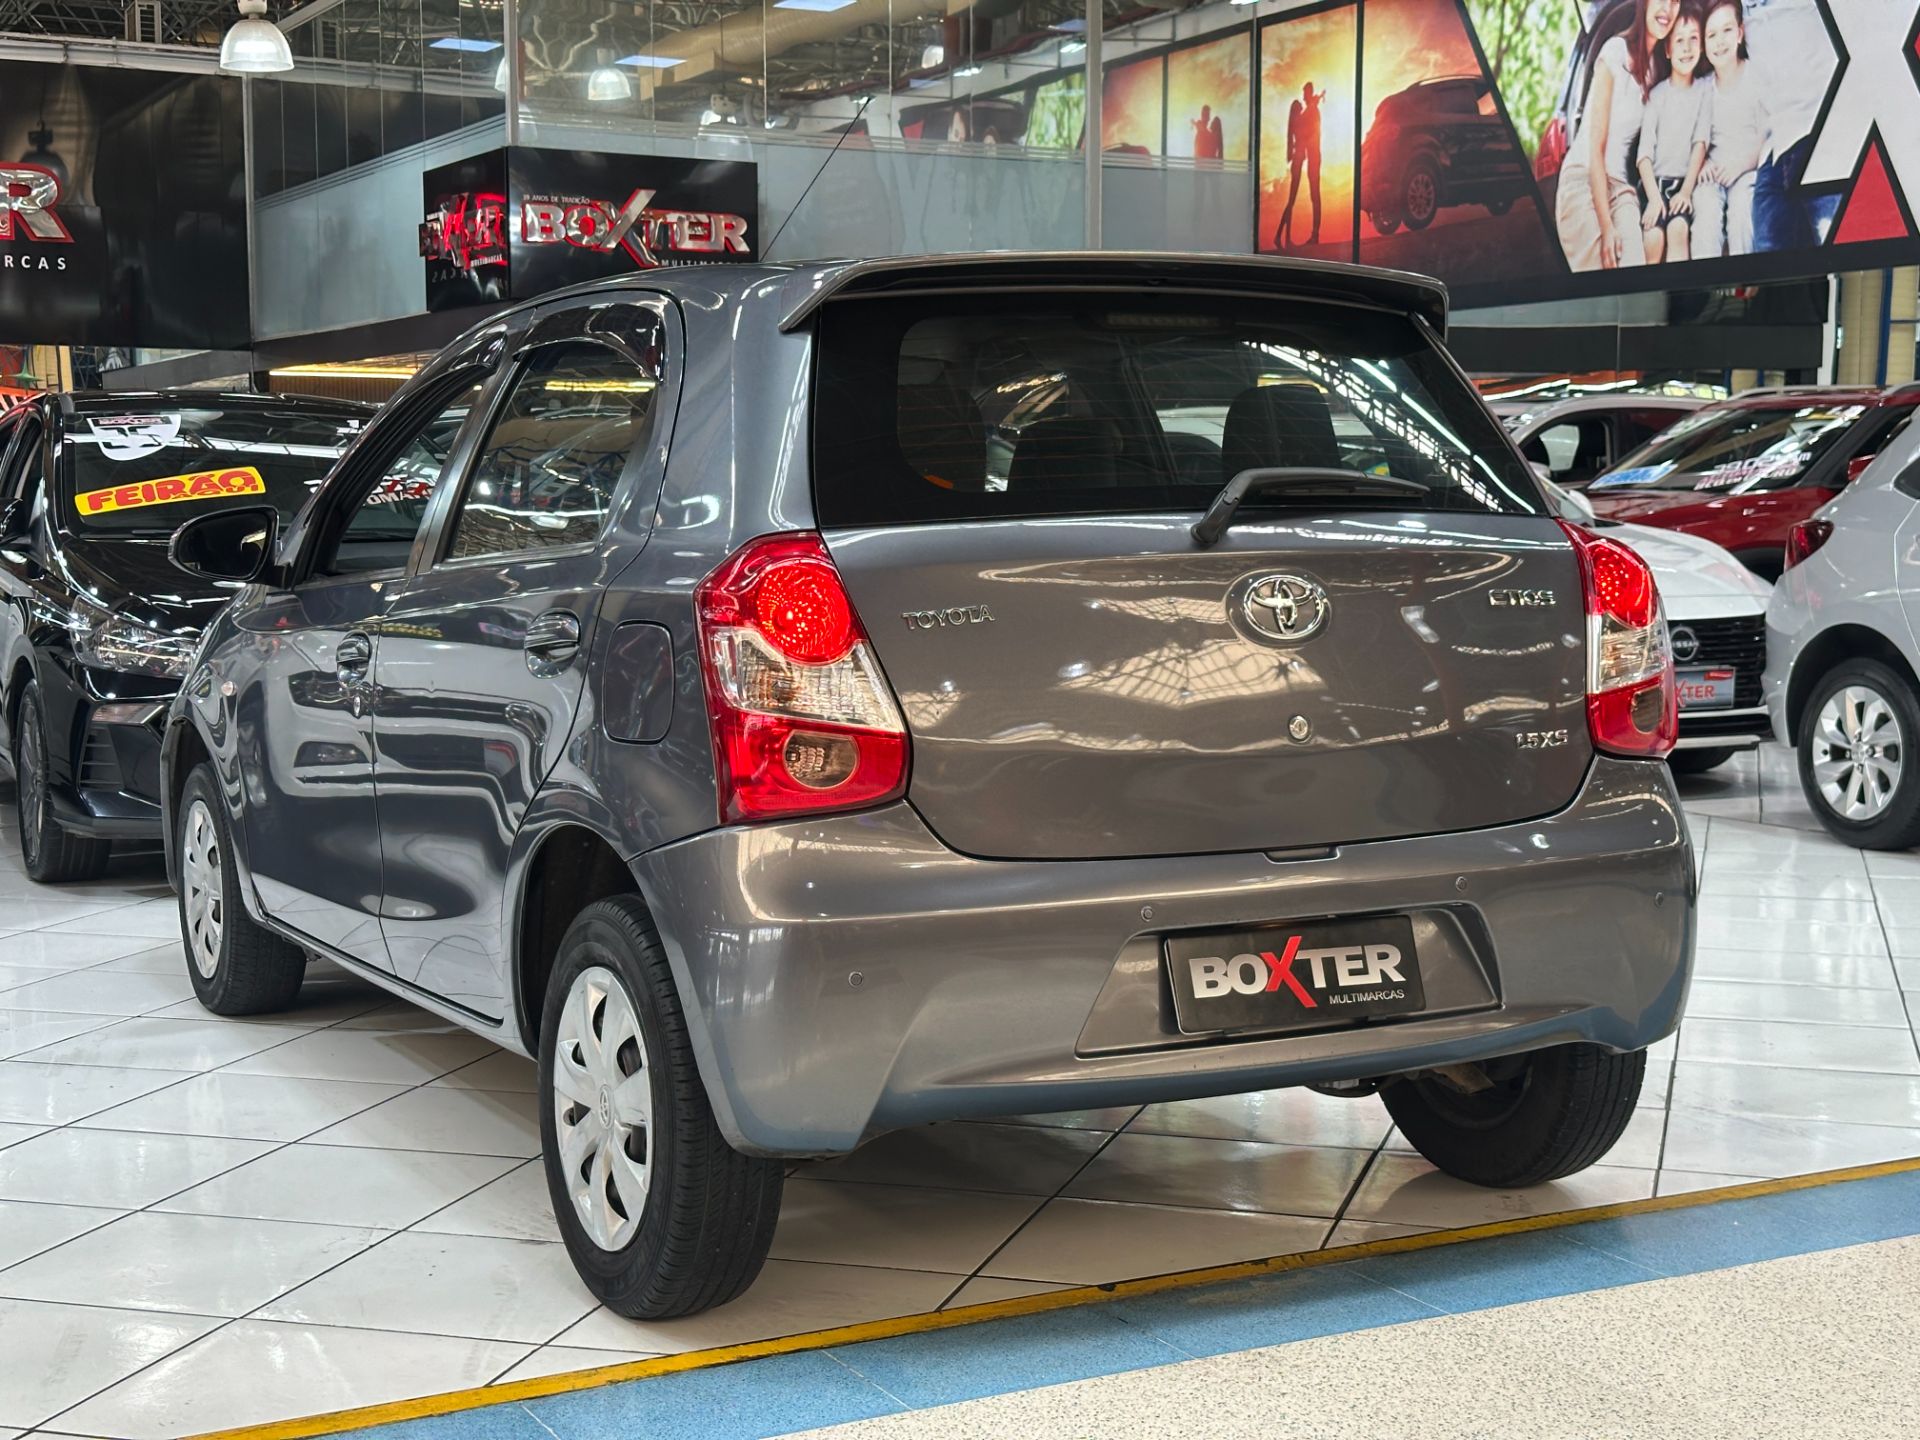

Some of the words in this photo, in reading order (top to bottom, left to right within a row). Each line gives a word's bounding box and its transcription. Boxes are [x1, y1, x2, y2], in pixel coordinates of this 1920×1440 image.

[521, 189, 750, 268] BOXTER
[87, 470, 256, 511] FEIRÃO
[1488, 589, 1556, 606] ETIOS
[902, 604, 995, 630] TOYOTA
[1188, 935, 1406, 1008] BOXTER
[1328, 988, 1405, 1005] MULTIMARCAS
